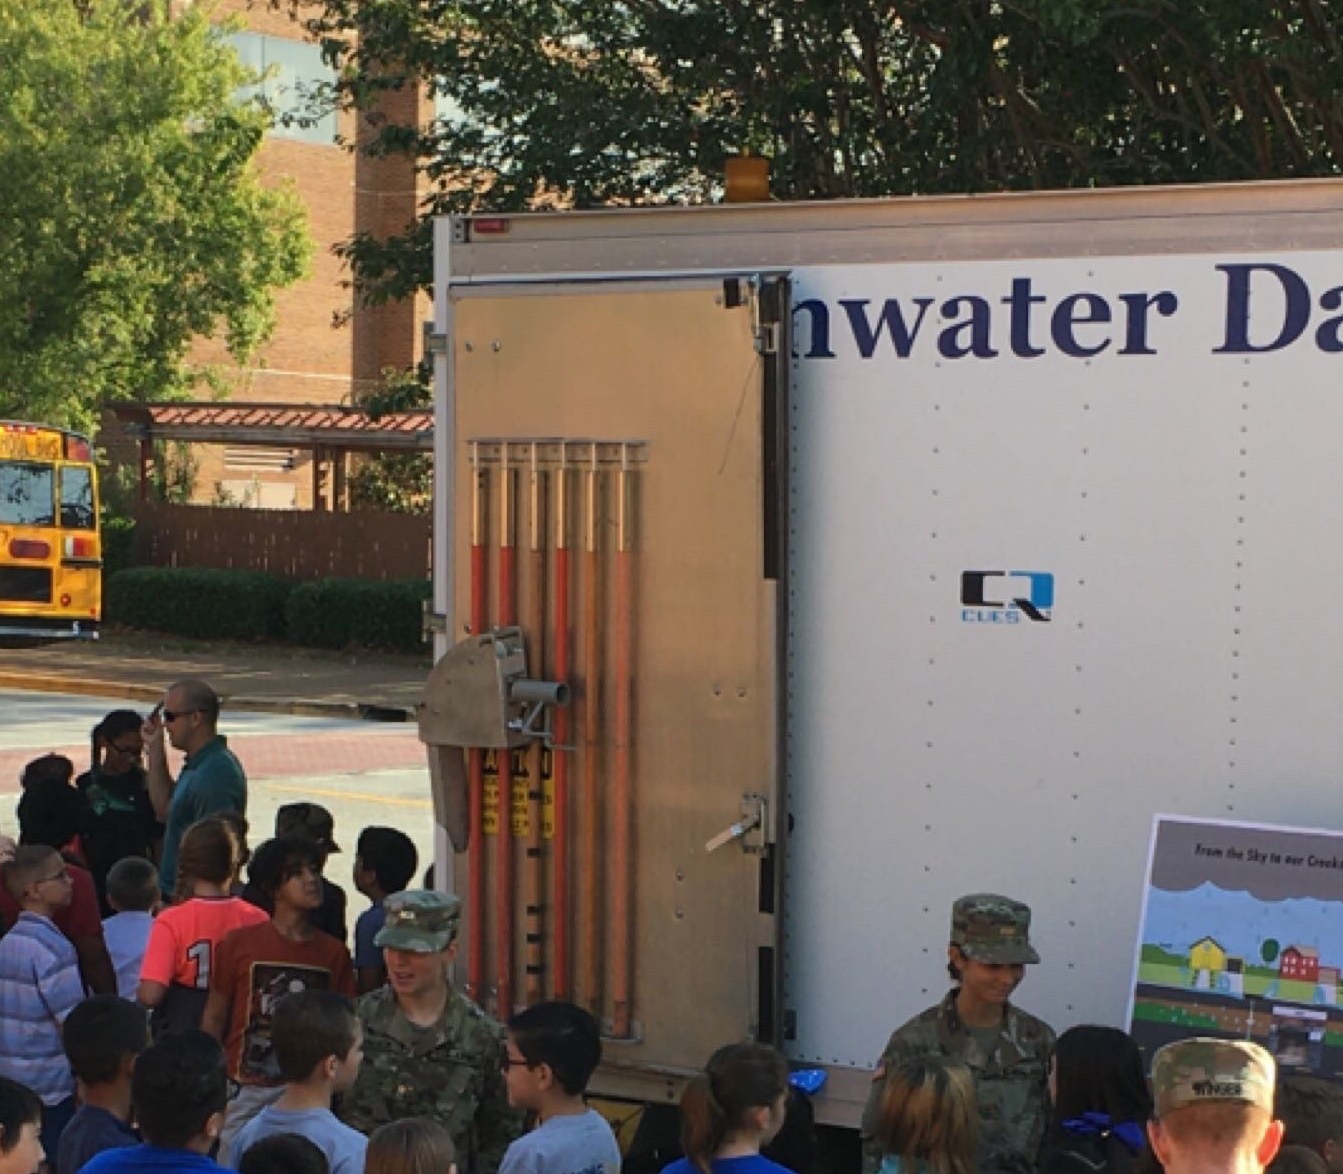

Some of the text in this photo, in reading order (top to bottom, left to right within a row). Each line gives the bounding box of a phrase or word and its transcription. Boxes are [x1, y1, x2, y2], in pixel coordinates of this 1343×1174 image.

[1194, 842, 1224, 857] From
[1225, 845, 1244, 861] the
[1246, 848, 1268, 864] Sky
[1270, 852, 1282, 865] to
[1284, 854, 1305, 868] our
